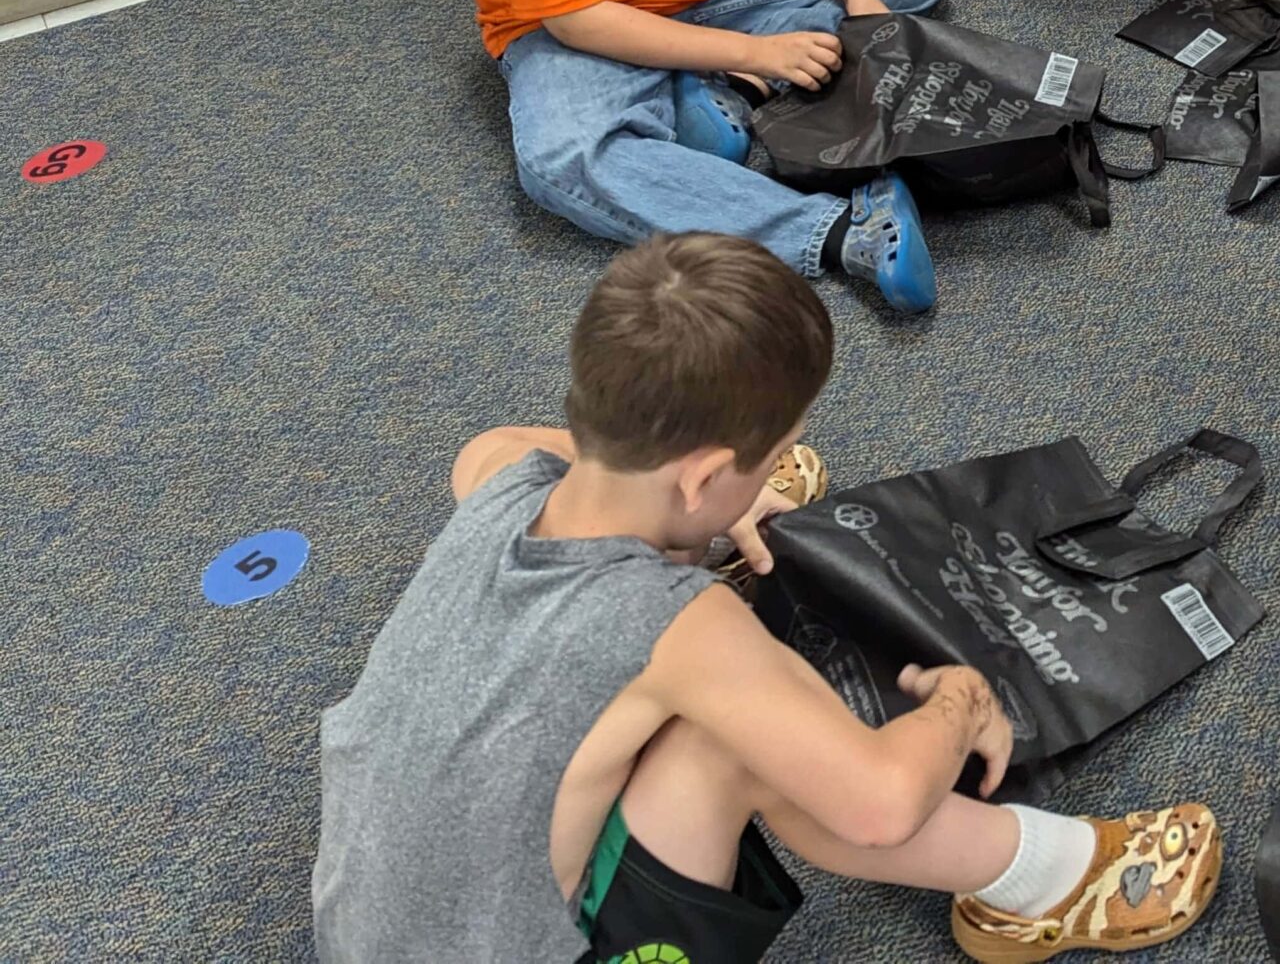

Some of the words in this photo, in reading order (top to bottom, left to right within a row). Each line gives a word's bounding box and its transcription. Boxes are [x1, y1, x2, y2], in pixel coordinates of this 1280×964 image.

[29, 143, 87, 179] Gg
[234, 549, 278, 583] 5
[951, 522, 1081, 686] Shopping
